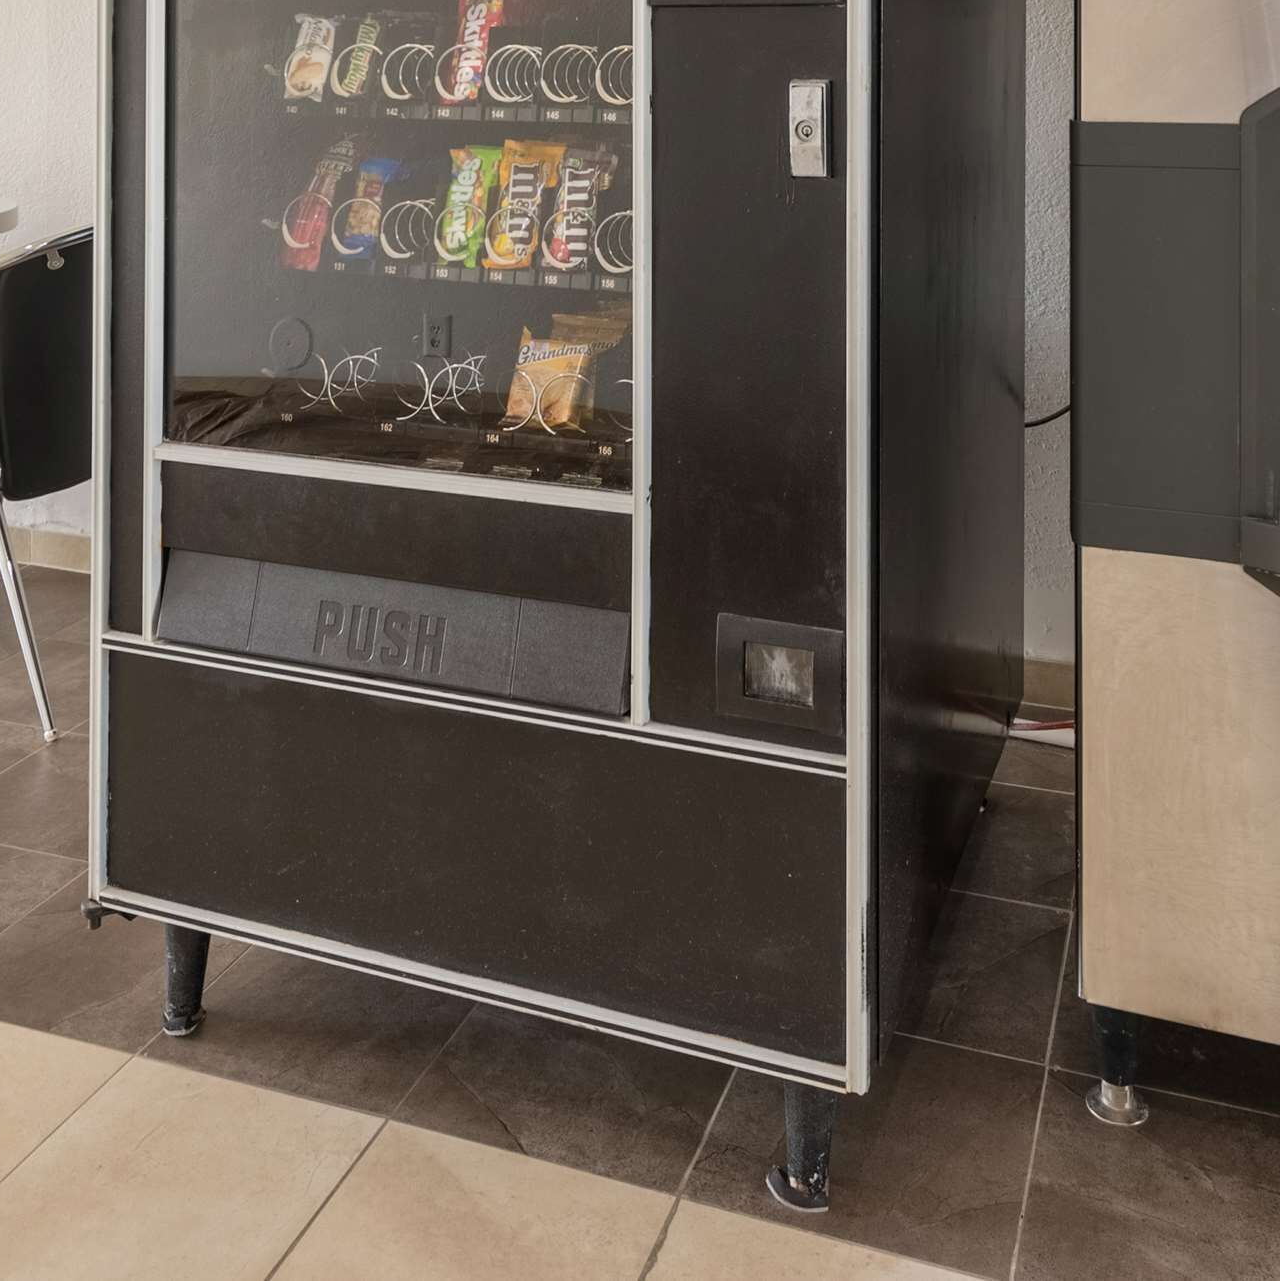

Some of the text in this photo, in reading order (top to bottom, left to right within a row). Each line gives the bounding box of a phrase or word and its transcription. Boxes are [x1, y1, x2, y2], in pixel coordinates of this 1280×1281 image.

[386, 107, 399, 116] 142
[437, 109, 450, 118] 143
[491, 110, 505, 119] 144
[546, 110, 560, 119] 145
[602, 112, 617, 122] 146
[446, 157, 482, 250] Skittles
[435, 268, 448, 278] 153
[489, 271, 503, 281] 154
[544, 275, 558, 285] 155
[280, 413, 613, 455] 160 162 164 166
[312, 599, 449, 676] PUSH
